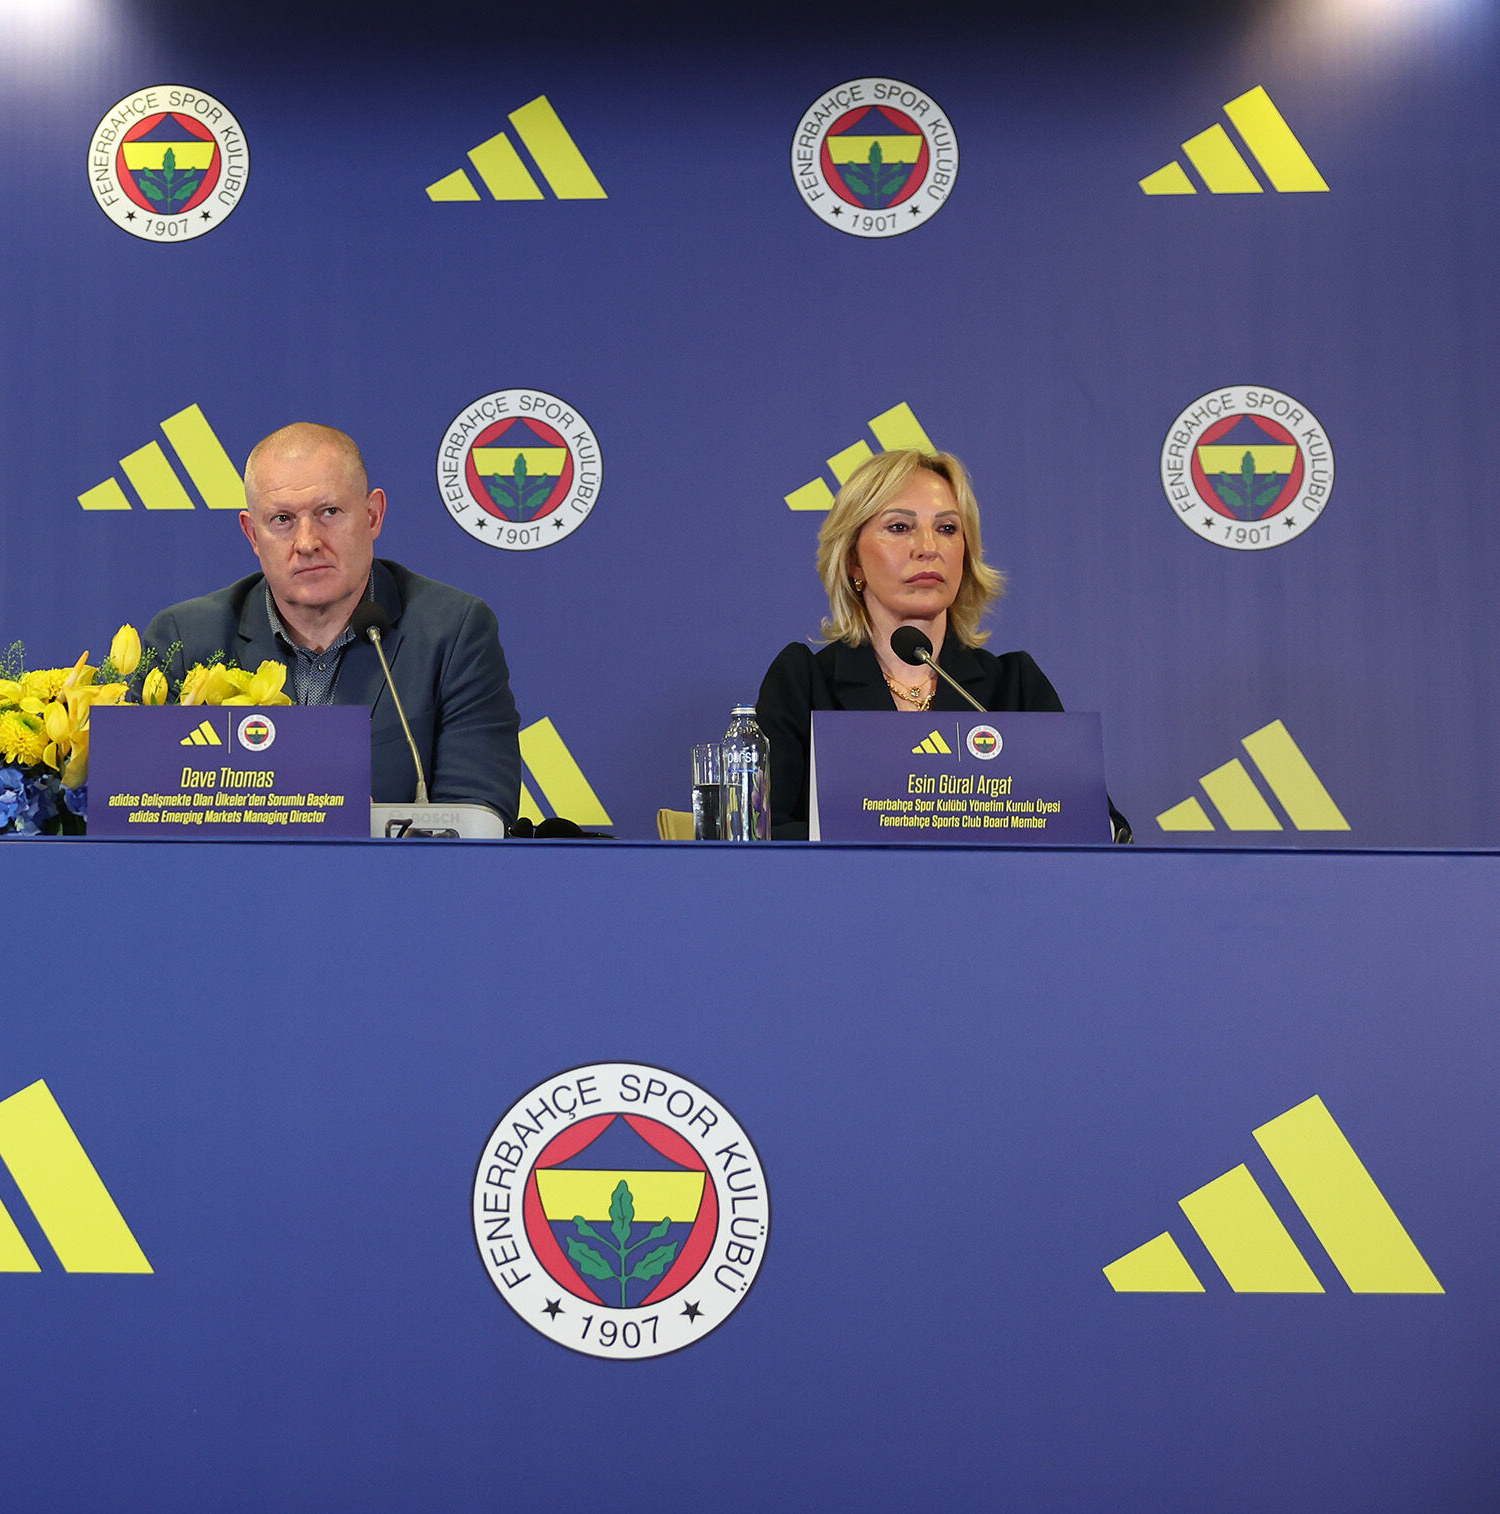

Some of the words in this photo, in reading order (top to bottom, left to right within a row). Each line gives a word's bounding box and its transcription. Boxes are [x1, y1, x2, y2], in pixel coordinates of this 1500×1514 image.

[94, 92, 159, 207] FENERBAHÇE
[168, 91, 223, 124] SPOR
[217, 125, 247, 206] KULÜBÜ
[797, 84, 864, 201] FENERBAHÇE
[873, 83, 930, 117] SPOR
[926, 118, 957, 200] KULÜBÜ
[145, 218, 188, 236] 1907
[852, 213, 897, 232] 1907
[443, 396, 510, 514] FENERBAHÇE
[518, 394, 575, 430] SPOR
[570, 431, 600, 514] KULÜBÜ
[1168, 392, 1236, 513] FENERBAHÇE
[1245, 391, 1304, 427] SPOR
[1301, 427, 1332, 513] KULÜBÜ
[496, 526, 541, 545] 1907
[1224, 525, 1271, 544] 1907
[180, 767, 216, 788] Dave
[219, 767, 275, 788] Thomas
[907, 774, 936, 794] Esin
[939, 774, 974, 794] Güral
[976, 775, 1013, 797] Argat
[108, 794, 140, 807] adidas
[140, 794, 192, 808] Gelişmekte
[193, 794, 214, 807] Olan
[267, 794, 306, 807] Sorumlu
[306, 794, 344, 808] Başkanı
[862, 798, 914, 812] Fenerbahçe
[914, 799, 936, 813] Spor
[936, 799, 968, 812] Kulübü
[968, 799, 1005, 812] Yönetim
[1005, 800, 1035, 812] Kurulu
[1035, 798, 1061, 814] Üyesi
[128, 810, 160, 823] adidas
[160, 810, 203, 825] Emerging
[204, 810, 242, 823] Markets
[242, 810, 288, 825] Managing
[289, 810, 327, 823] Director
[411, 812, 460, 824] BOSCH
[879, 814, 931, 828] Fenerbahçe
[931, 815, 961, 829] Sports
[961, 815, 982, 828] Club
[983, 815, 1009, 828] Board
[1010, 816, 1047, 829] Member
[482, 1075, 602, 1290] FENERBAHÇE
[618, 1073, 719, 1138] SPOR
[714, 1141, 765, 1294] KULÜBÜ
[580, 1314, 660, 1349] 1907
